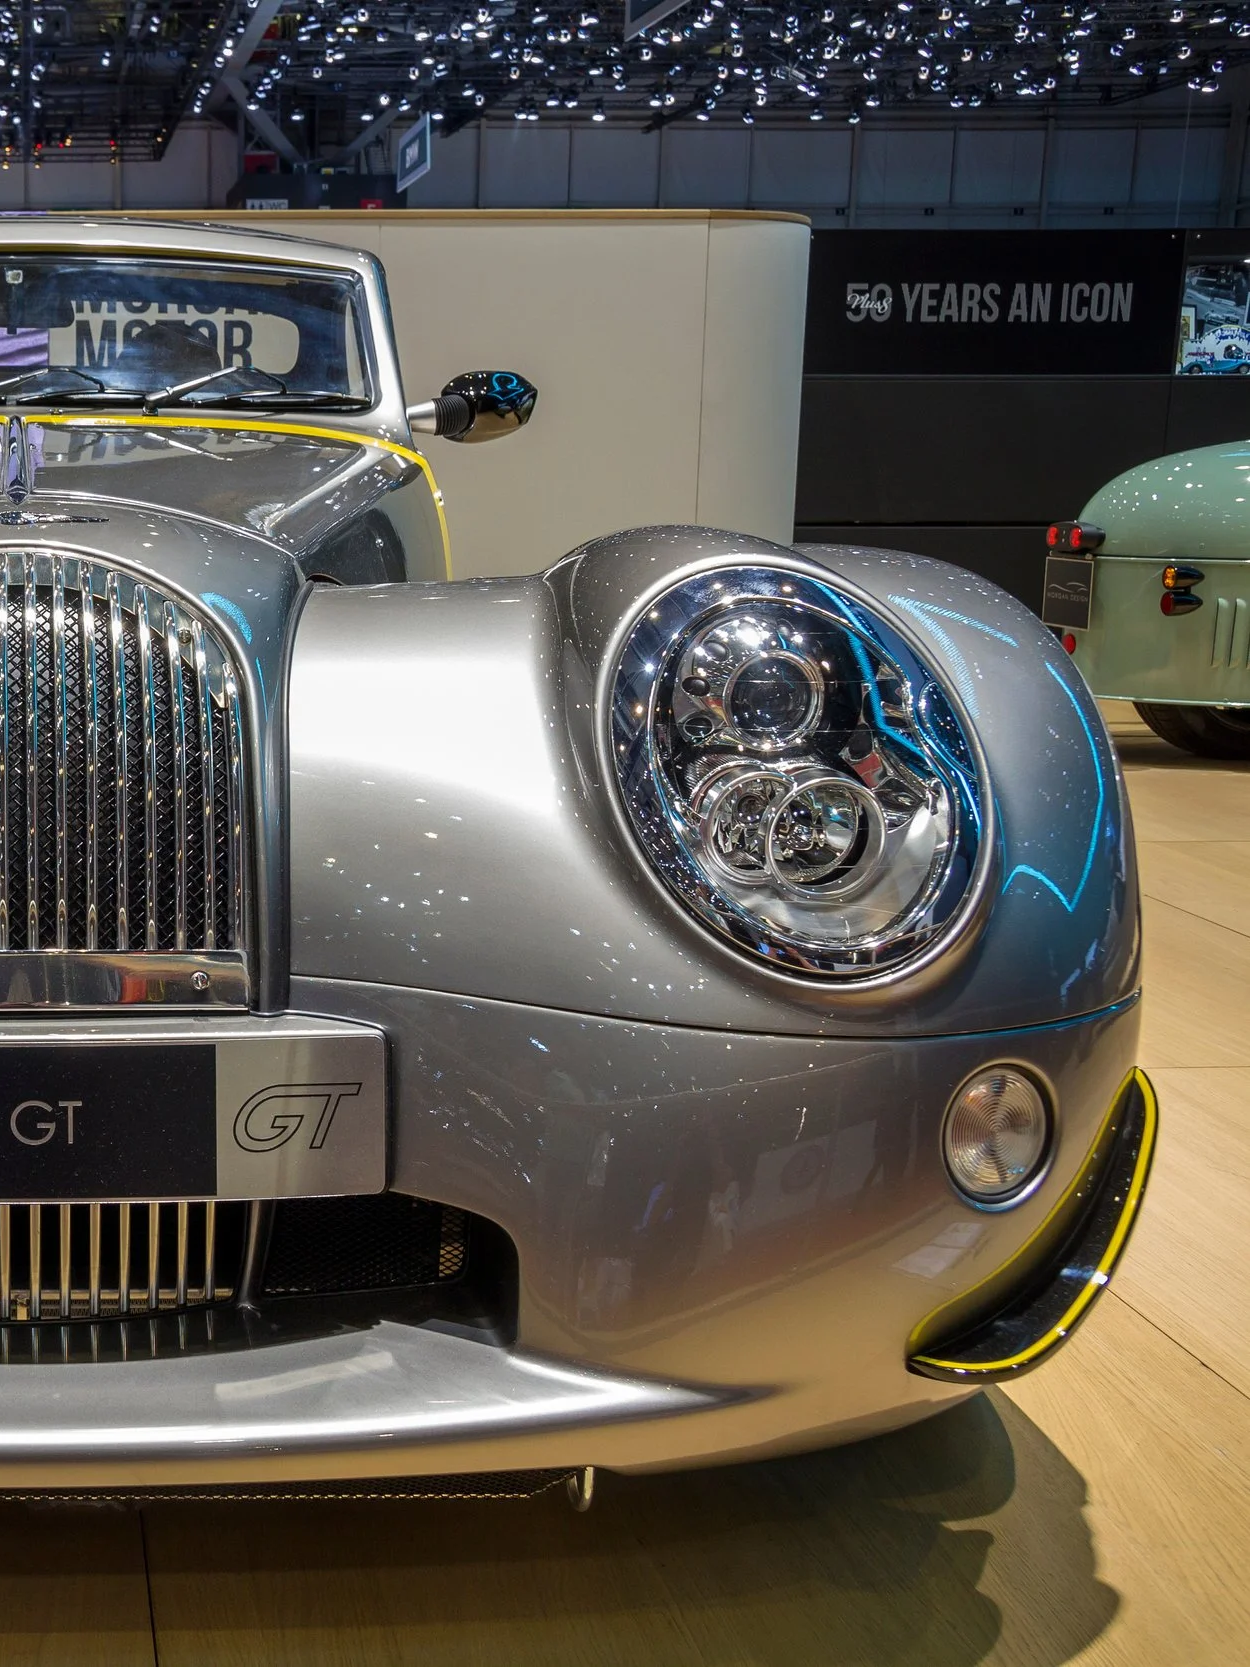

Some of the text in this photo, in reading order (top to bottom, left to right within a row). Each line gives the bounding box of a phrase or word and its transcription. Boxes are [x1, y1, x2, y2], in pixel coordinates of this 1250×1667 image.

[901, 283, 1001, 322] YEARS
[1007, 283, 1052, 322] AN
[1060, 283, 1134, 322] ICON
[10, 1100, 83, 1146] GT
[233, 1082, 363, 1154] GT
